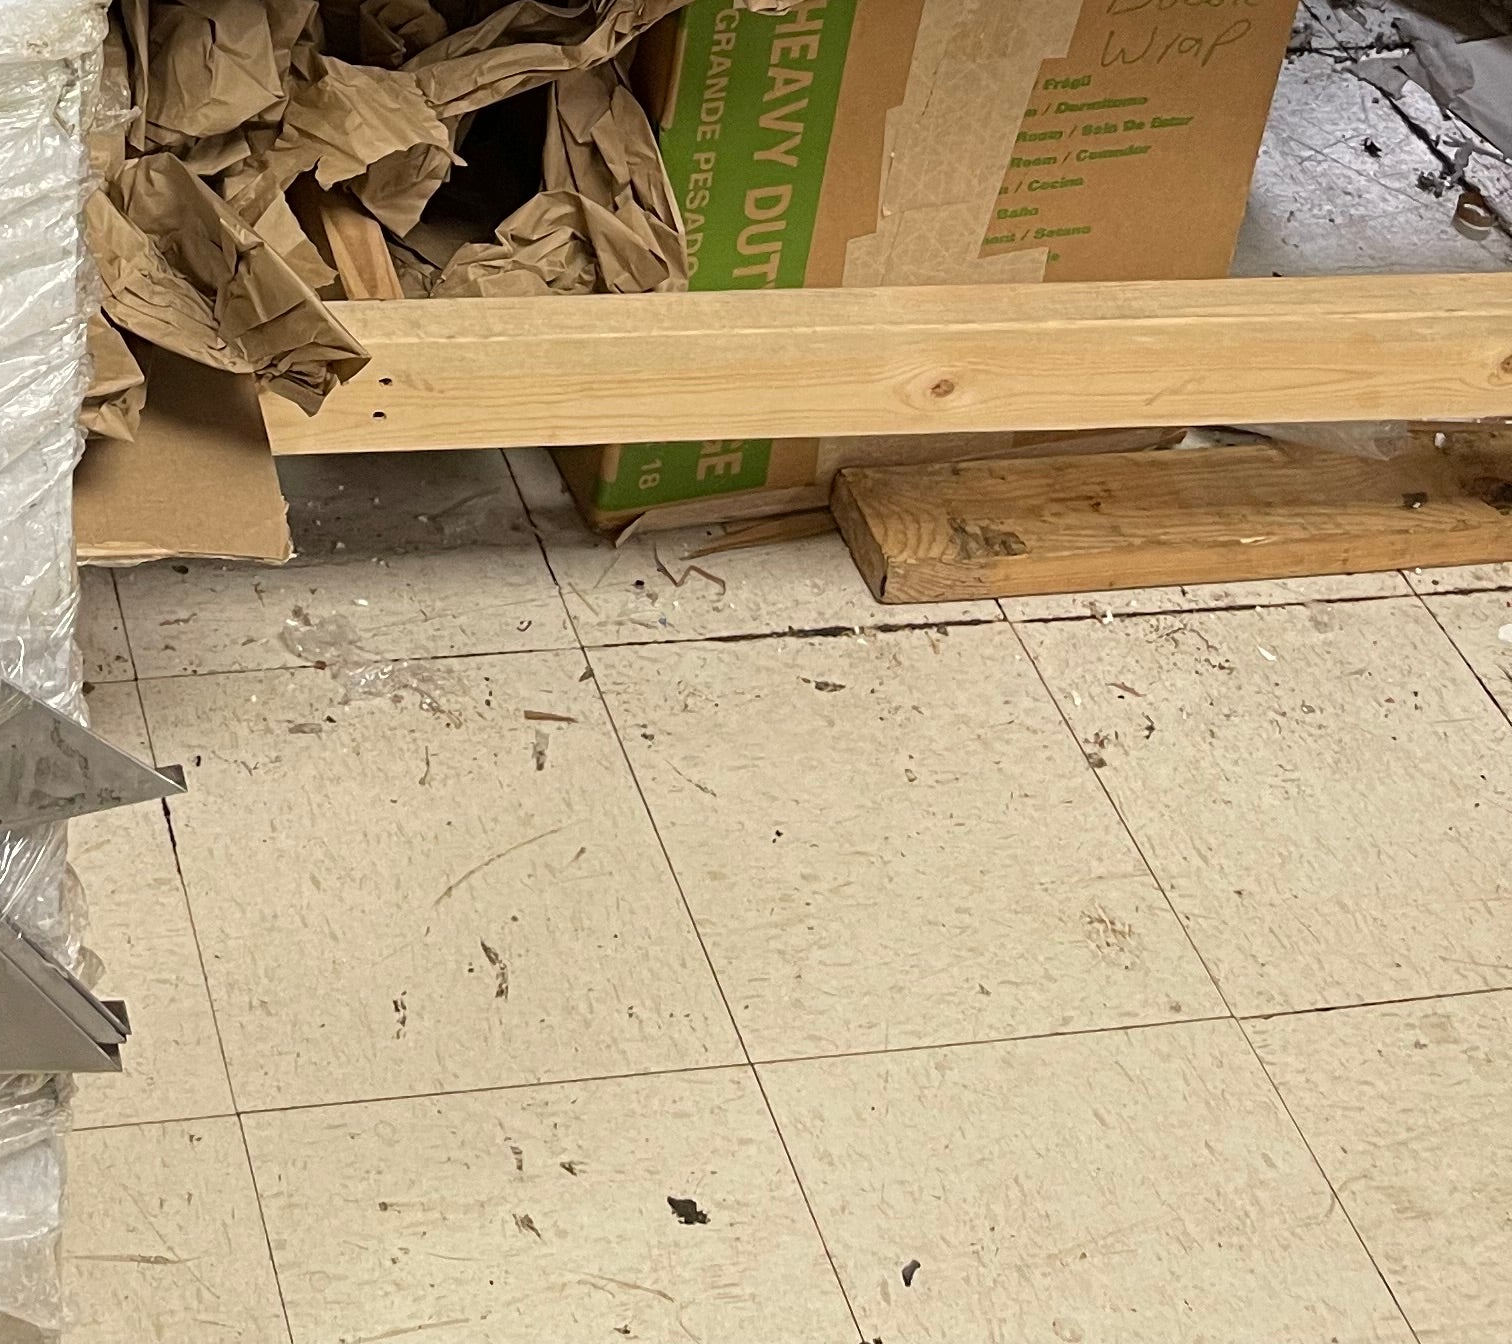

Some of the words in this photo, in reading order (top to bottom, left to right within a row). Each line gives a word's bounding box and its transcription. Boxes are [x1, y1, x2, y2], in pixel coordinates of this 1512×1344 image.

[696, 8, 740, 142] GRANDE
[732, 183, 793, 289] DUT
[639, 458, 663, 490] 18
